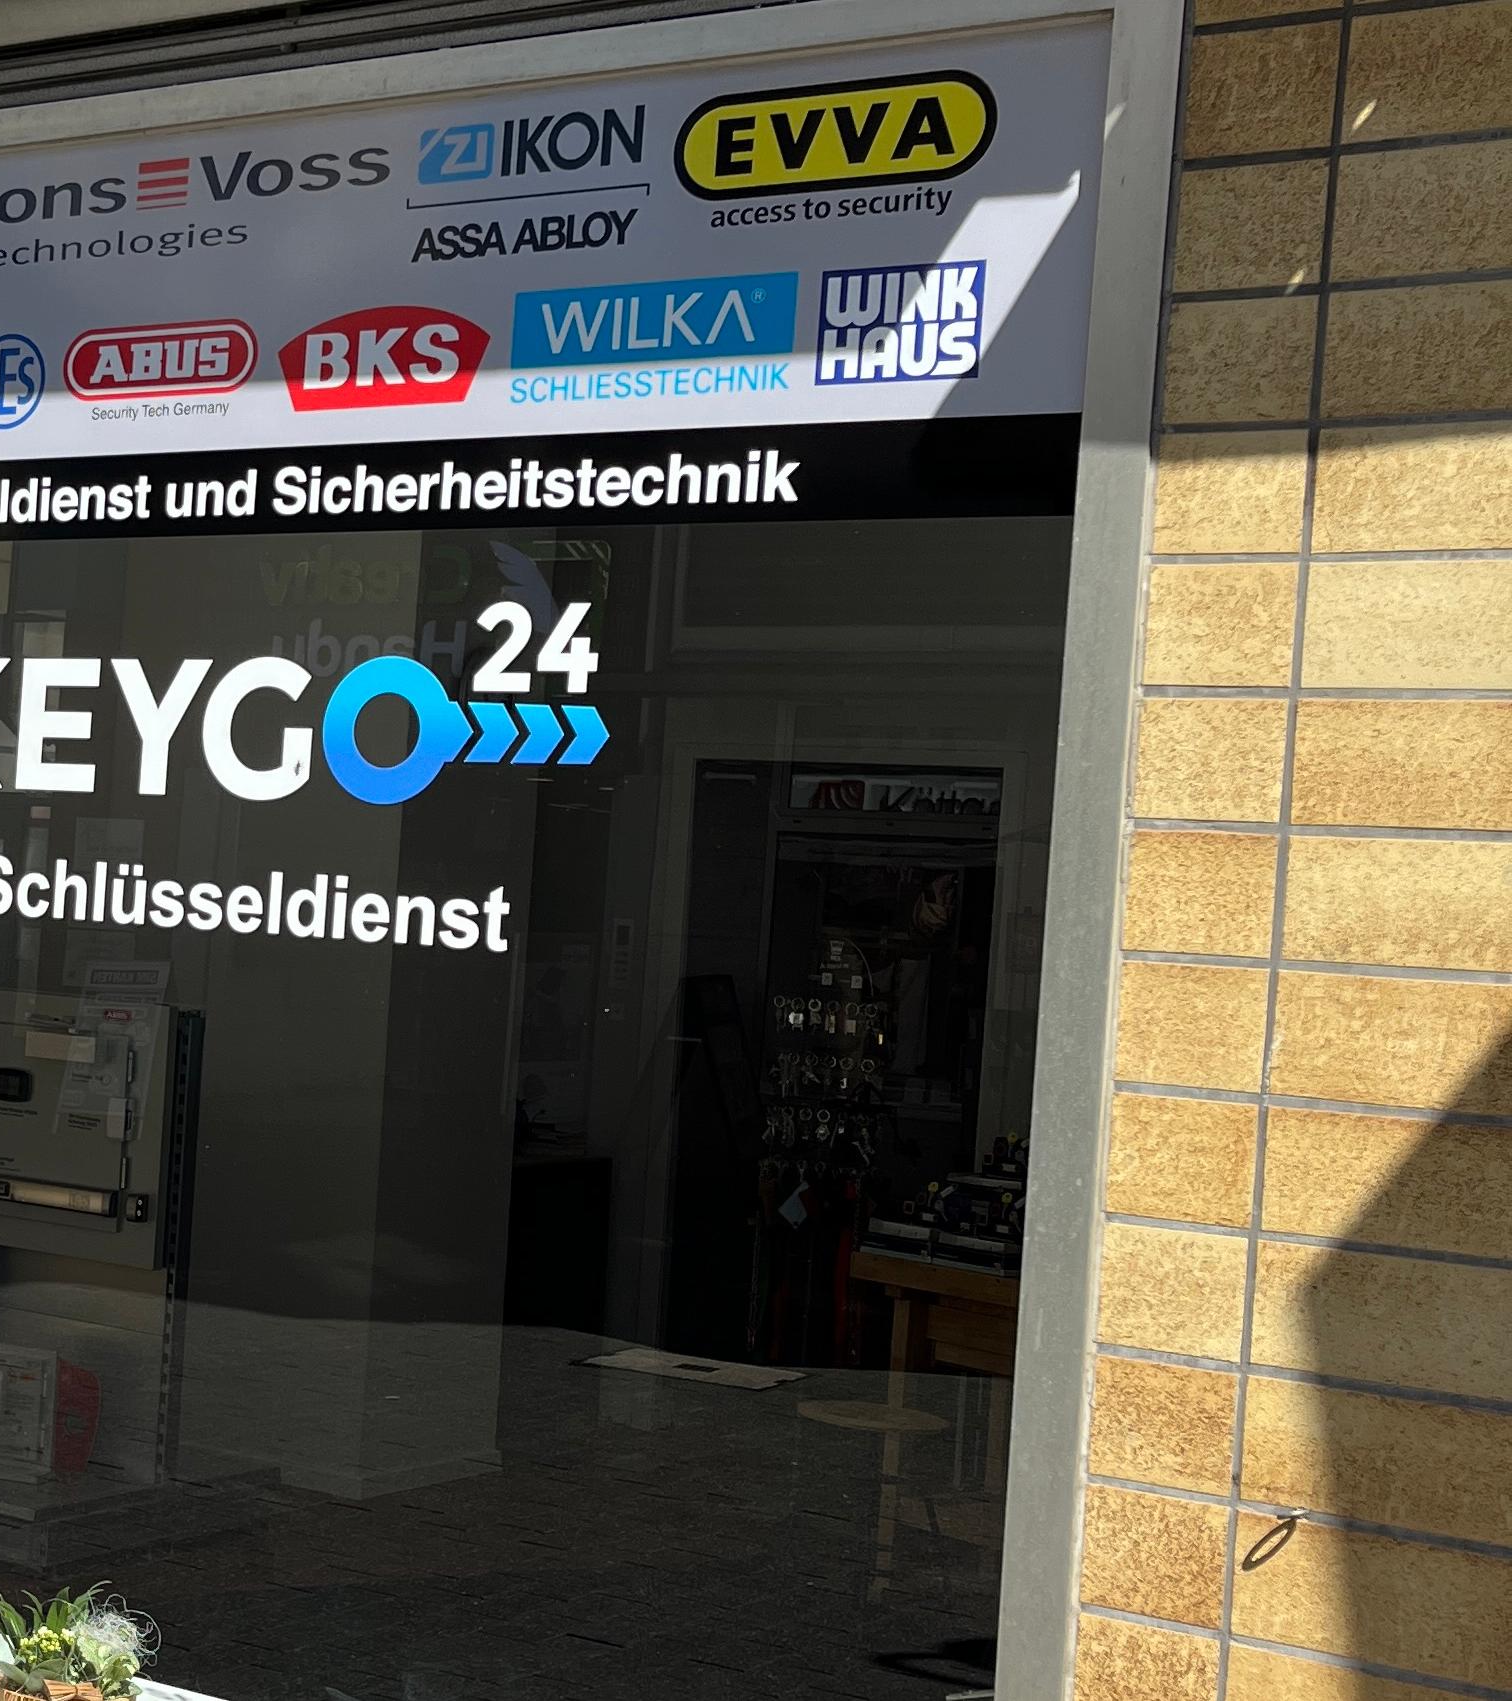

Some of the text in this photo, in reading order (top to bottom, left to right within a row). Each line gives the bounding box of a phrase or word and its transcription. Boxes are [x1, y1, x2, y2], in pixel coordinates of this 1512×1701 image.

[501, 105, 645, 178] IKON
[713, 96, 956, 177] EVVA
[200, 147, 391, 201] Voss
[411, 208, 639, 263] ASSA ABLOY
[710, 186, 953, 229] access to security
[541, 289, 755, 355] WILKA
[826, 264, 978, 327] WINK
[88, 336, 231, 384] ABUS
[303, 323, 460, 391] BKS
[820, 319, 978, 380] HAUS
[91, 397, 230, 423] Security Tech Germany
[510, 362, 789, 404] SCHLIESSTECHNIK
[164, 464, 257, 518] und
[271, 451, 800, 515] Sicherheitstechnik
[472, 601, 598, 694] 24
